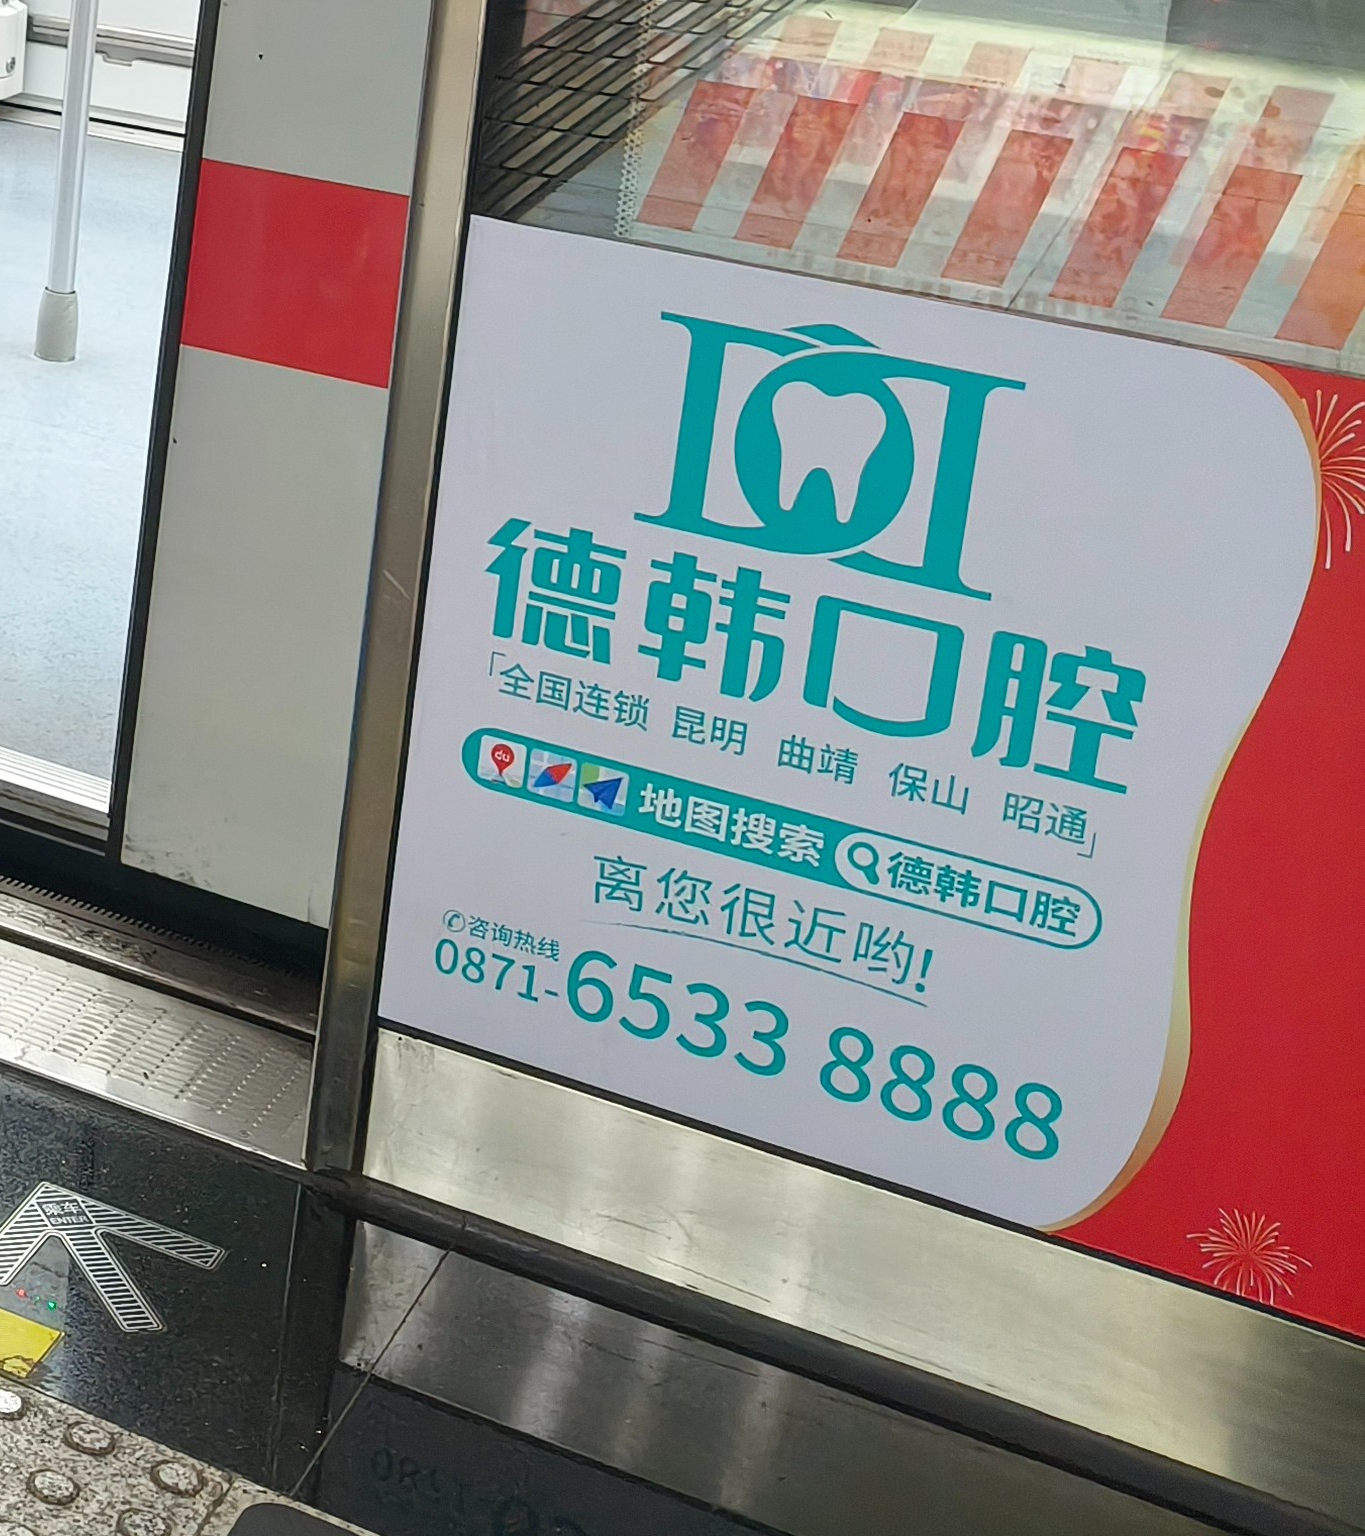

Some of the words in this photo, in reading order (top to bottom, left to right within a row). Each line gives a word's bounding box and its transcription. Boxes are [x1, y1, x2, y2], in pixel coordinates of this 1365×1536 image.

[483, 515, 1148, 797] 德韩口腔
[672, 704, 748, 757] 昆明
[777, 733, 859, 786] 曲靖
[887, 761, 970, 816] 保山
[637, 781, 827, 870] 地图搜索
[467, 913, 562, 964] 咨询热线
[885, 848, 1081, 939] 德韩口腔
[817, 1023, 1064, 1163] 8888
[40, 1200, 82, 1216] 乘车
[49, 1214, 91, 1225] ENTER
